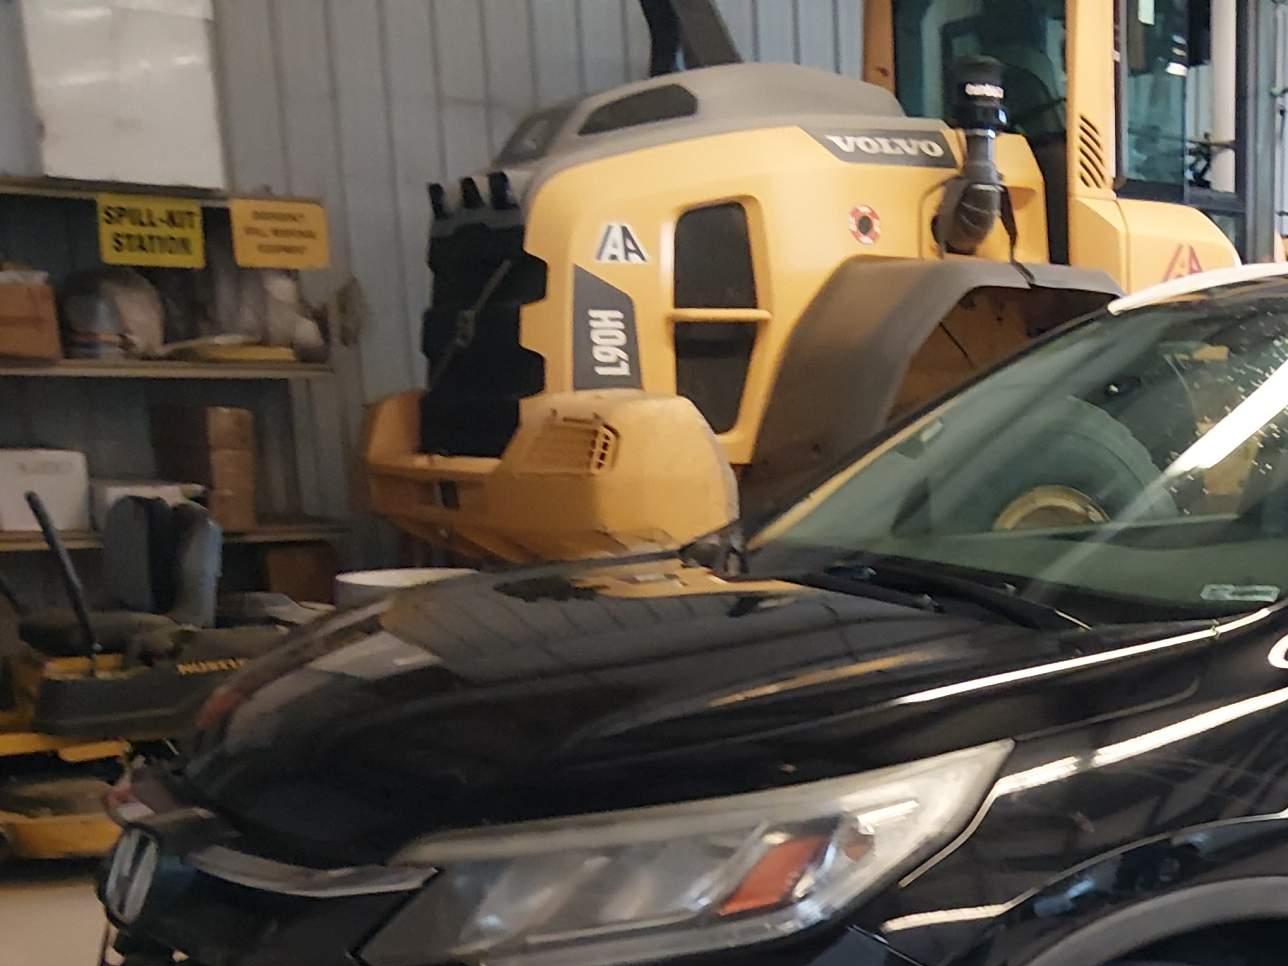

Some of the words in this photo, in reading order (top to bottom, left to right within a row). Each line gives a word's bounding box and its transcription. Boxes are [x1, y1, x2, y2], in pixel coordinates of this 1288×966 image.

[824, 134, 945, 158] VOLVO
[103, 205, 196, 229] SPILL-KIT
[112, 231, 193, 256] STATION
[587, 308, 632, 377] L90H
